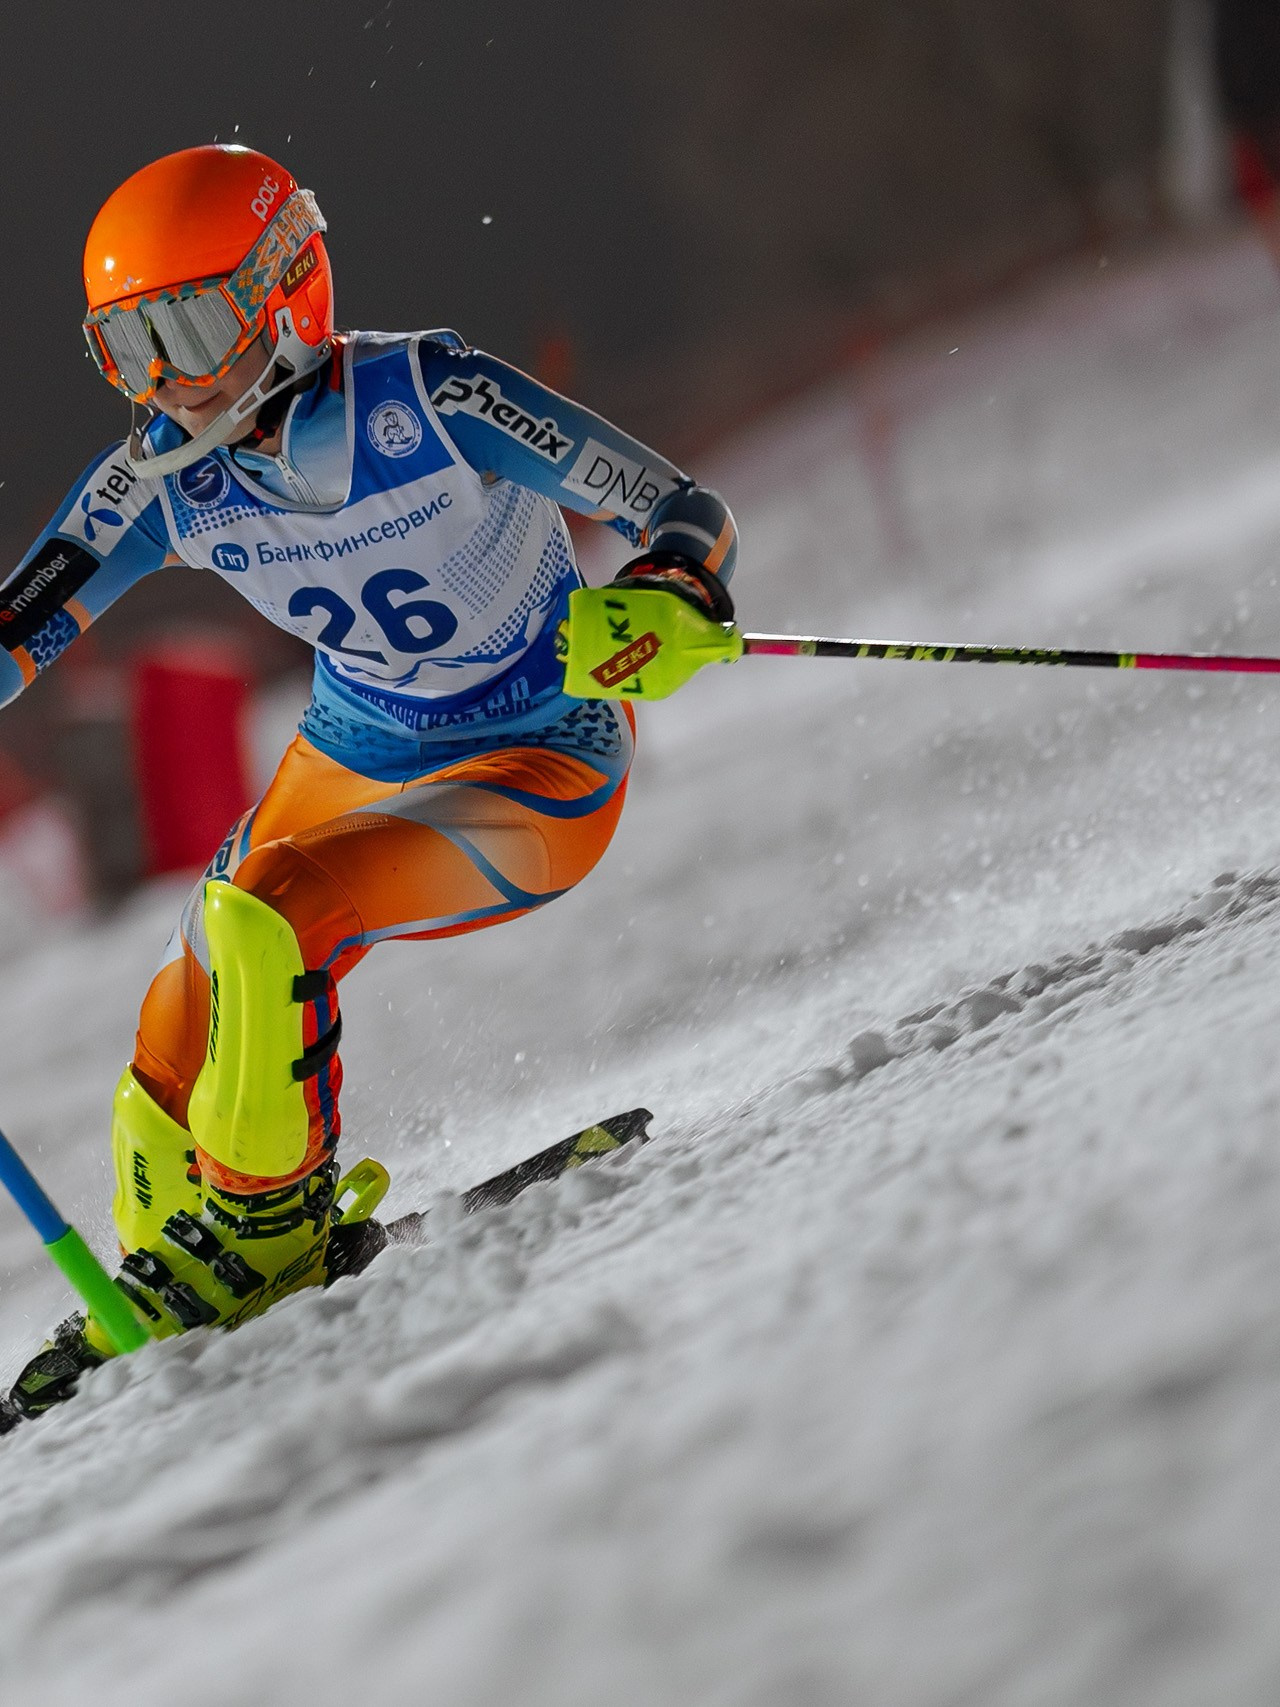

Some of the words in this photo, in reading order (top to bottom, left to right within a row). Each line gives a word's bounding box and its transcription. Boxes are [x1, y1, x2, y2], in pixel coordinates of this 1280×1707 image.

[251, 175, 280, 222] poc
[286, 251, 315, 286] LEKI
[96, 458, 140, 506] tel
[584, 456, 660, 513] DNB
[256, 491, 454, 566] Банкфинсервис
[288, 568, 458, 665] 26
[601, 640, 654, 681] LEKI
